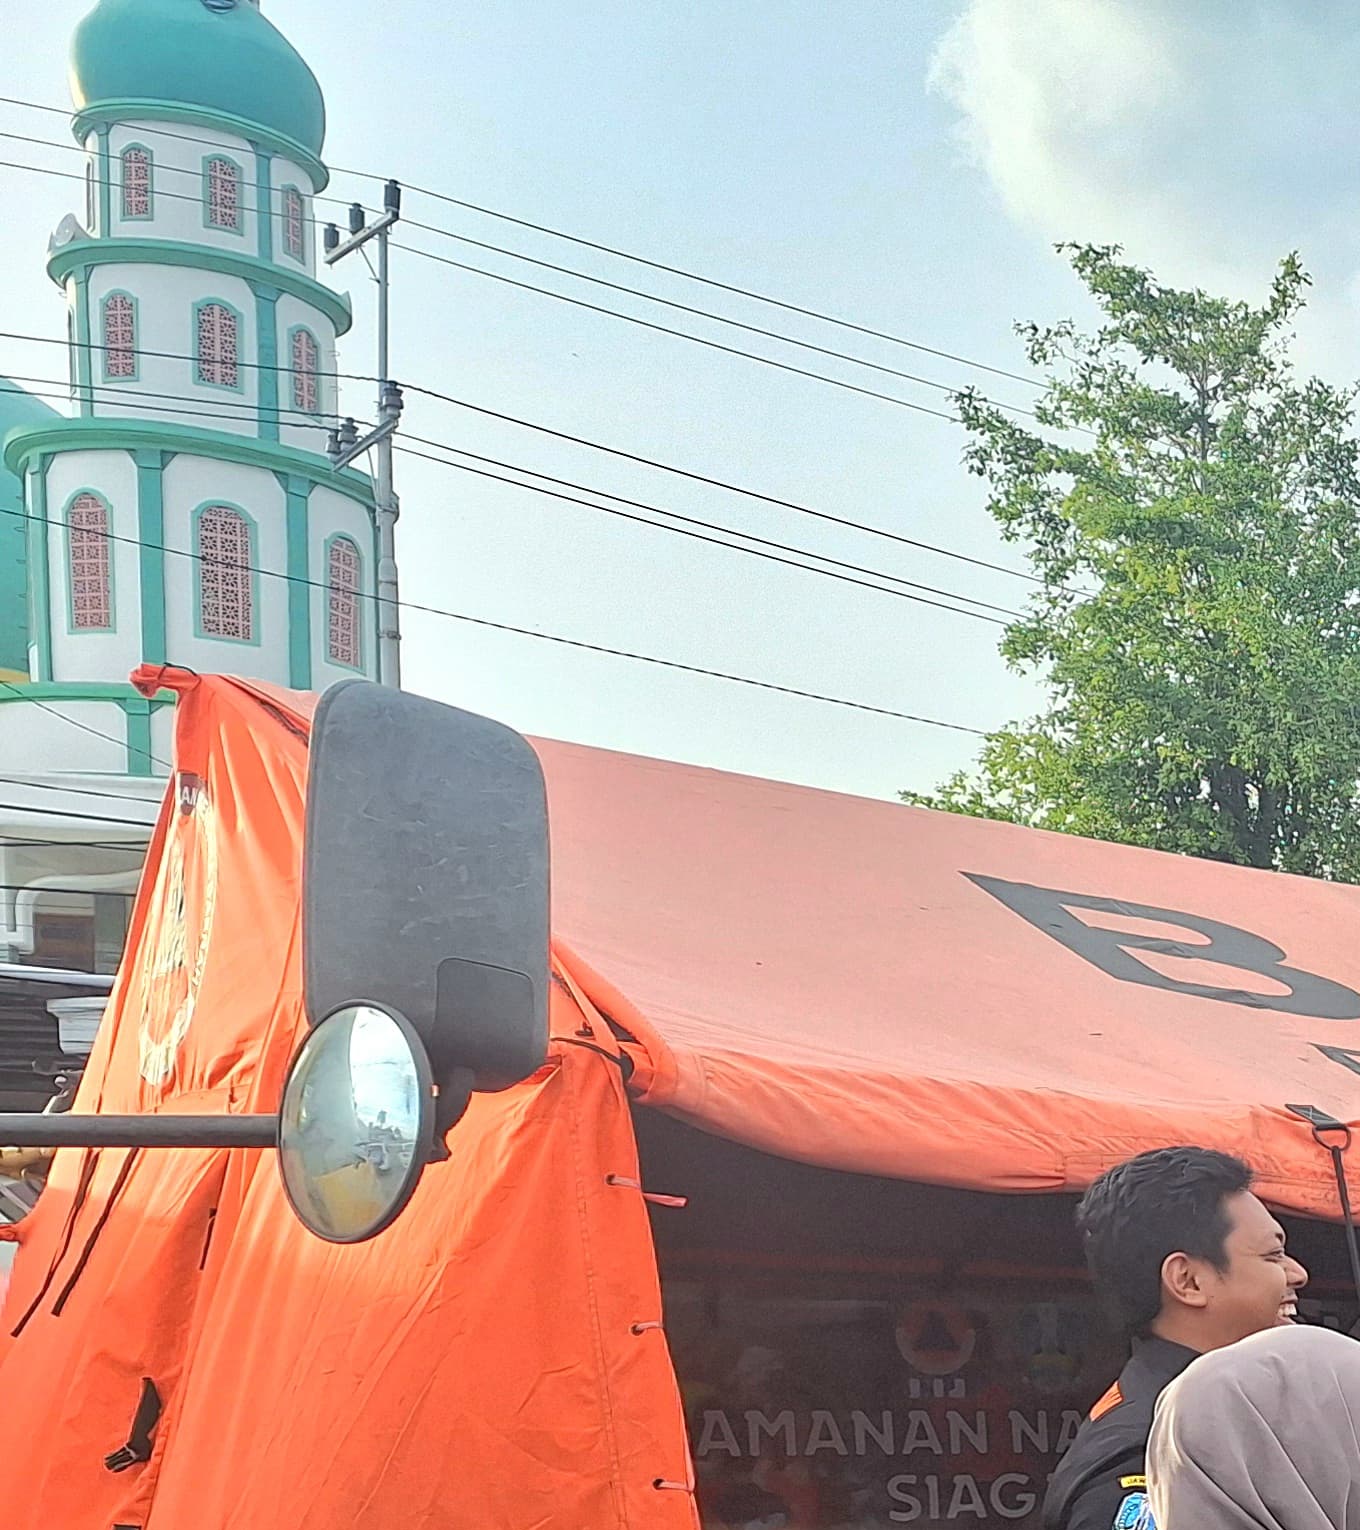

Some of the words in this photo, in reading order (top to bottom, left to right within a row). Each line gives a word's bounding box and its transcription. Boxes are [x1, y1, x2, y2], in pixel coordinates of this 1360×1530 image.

[697, 1410, 988, 1457] AMANAN
[1009, 1410, 1092, 1454] NA
[887, 1473, 1055, 1522] SIAG
